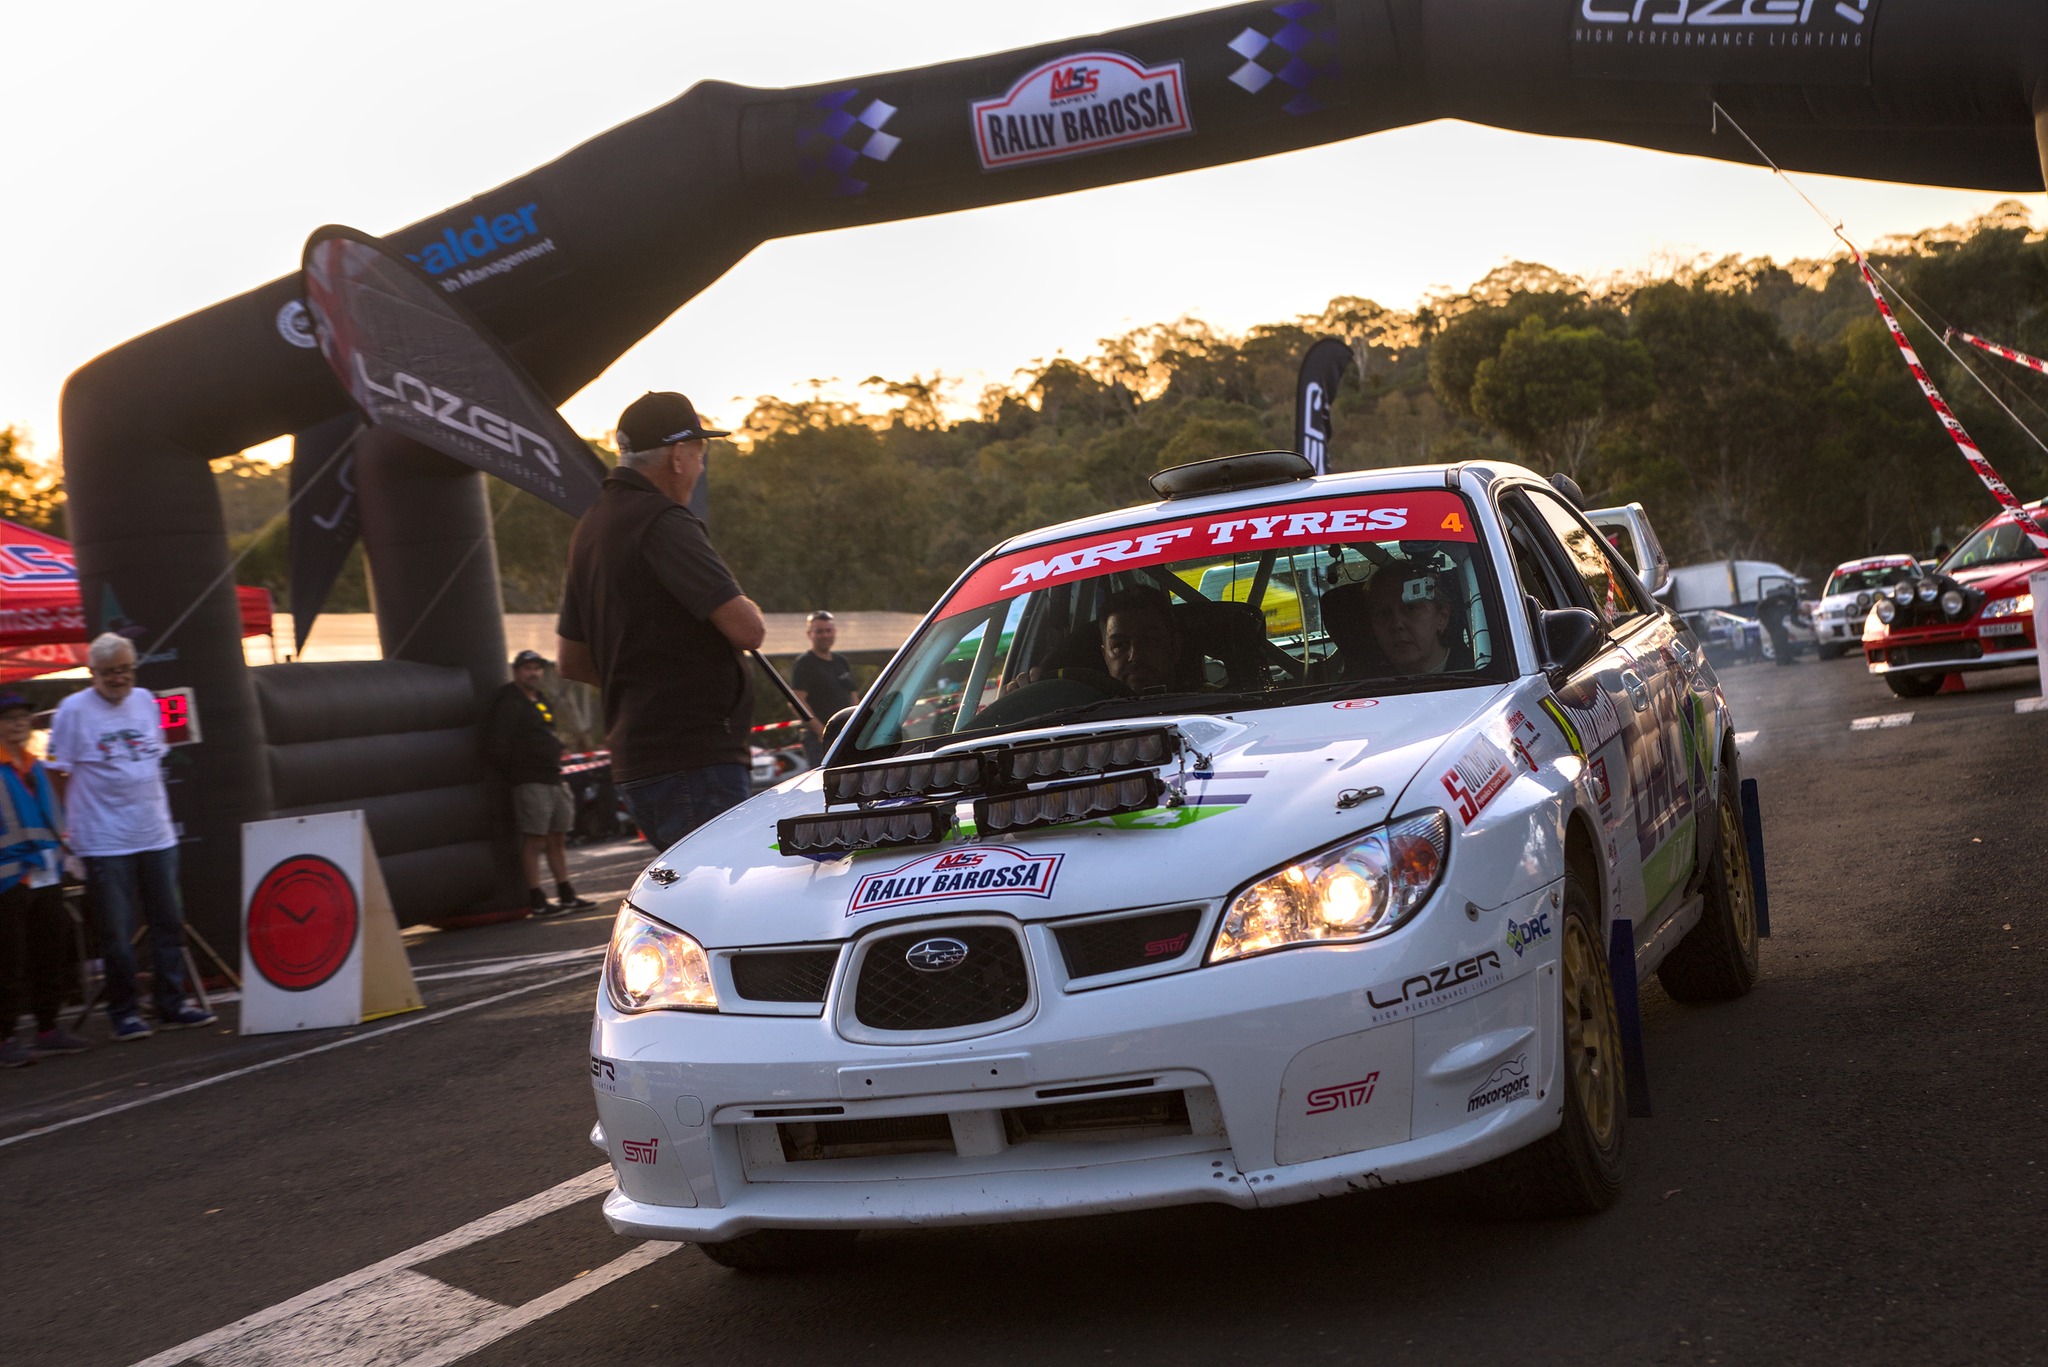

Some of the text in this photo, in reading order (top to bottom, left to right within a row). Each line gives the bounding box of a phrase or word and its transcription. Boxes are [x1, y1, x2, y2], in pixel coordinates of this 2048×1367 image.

[1575, 29, 1862, 47] HIGH PERFORMANCE LIGHTING
[987, 82, 1174, 156] RALLY BAROSSA
[1050, 92, 1099, 108] SAFETY
[354, 351, 563, 478] LAZER
[999, 507, 1464, 592] MRF TYRES 4
[863, 863, 1041, 903] RALLY BAROSSA
[1519, 913, 1552, 946] DRC
[1366, 950, 1501, 1010] LAZER
[1372, 971, 1504, 1023] HIGH PERFORMANCE LIGHTING
[1467, 1075, 1530, 1113] motorsport
